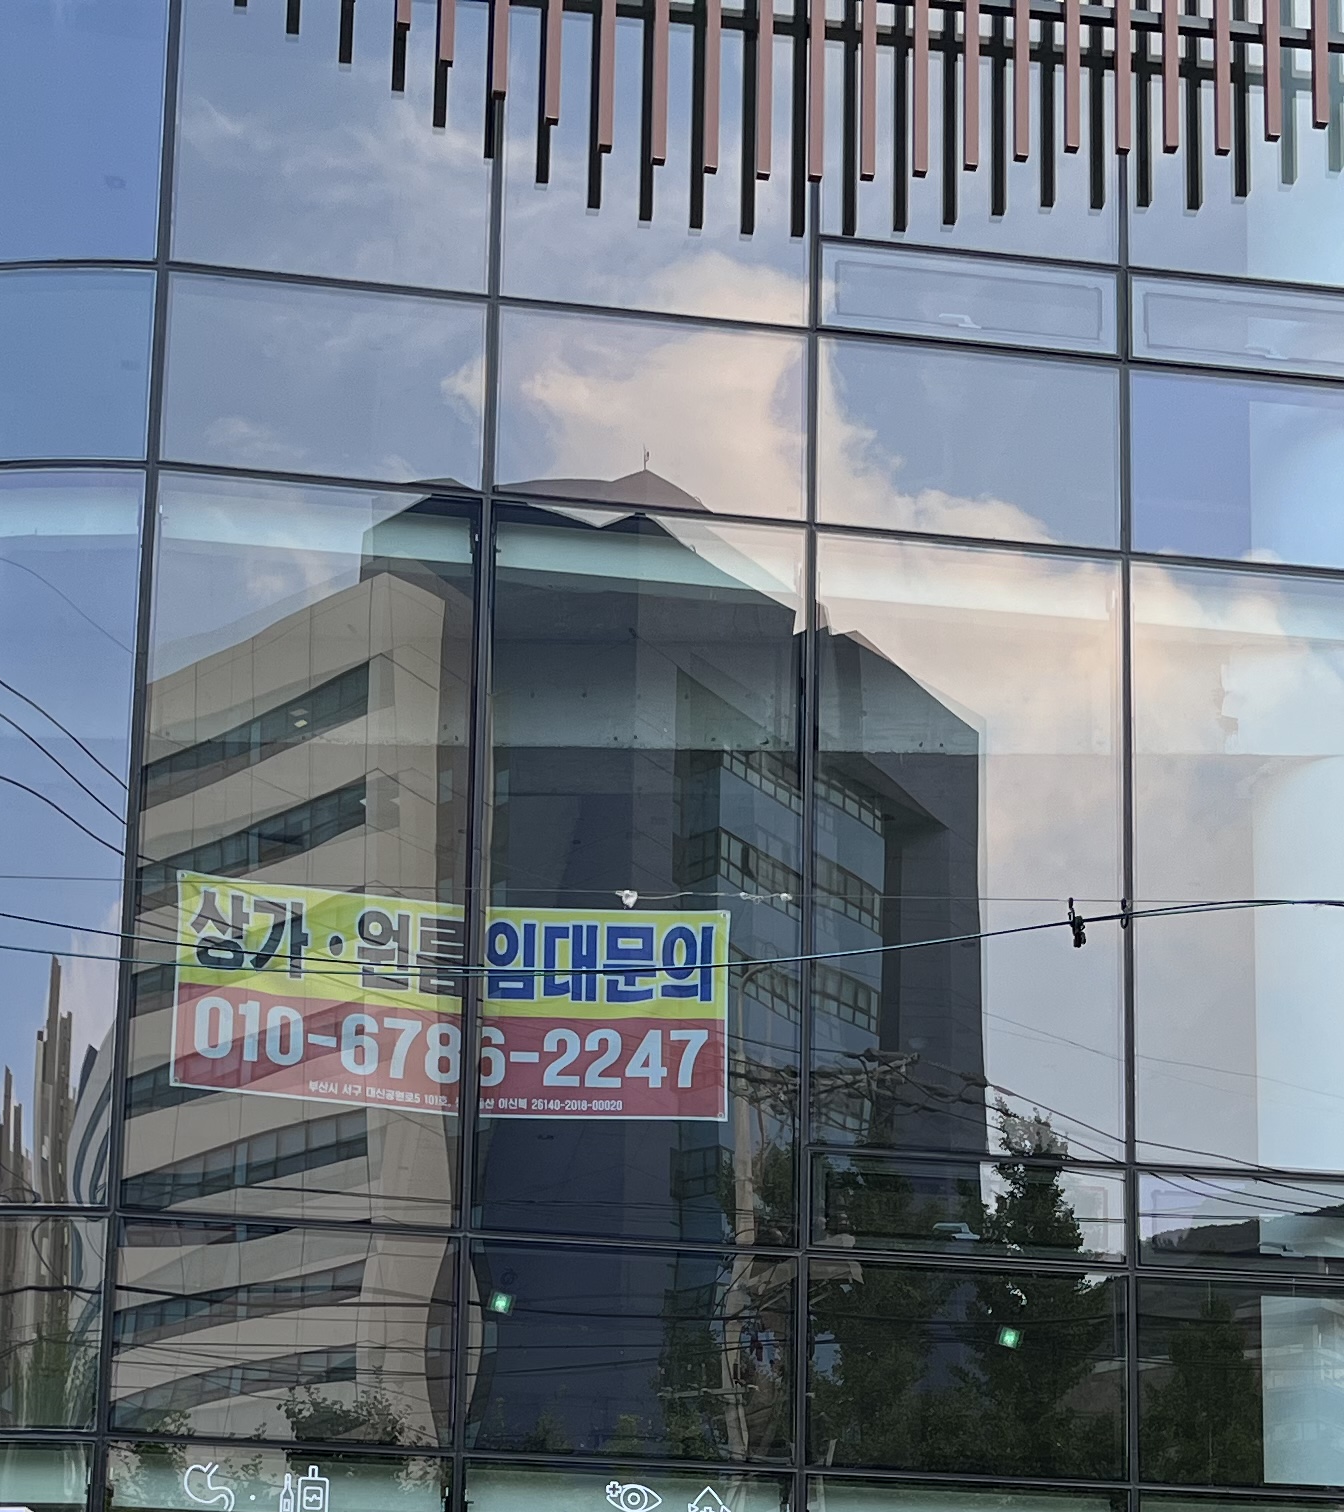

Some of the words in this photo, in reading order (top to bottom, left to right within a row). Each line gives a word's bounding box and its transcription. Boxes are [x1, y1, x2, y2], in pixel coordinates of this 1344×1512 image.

[487, 920, 716, 1003] 임대문의
[193, 997, 709, 1089] 010-6786-2247
[309, 1080, 338, 1094] 부산시
[342, 1084, 362, 1096] 서구
